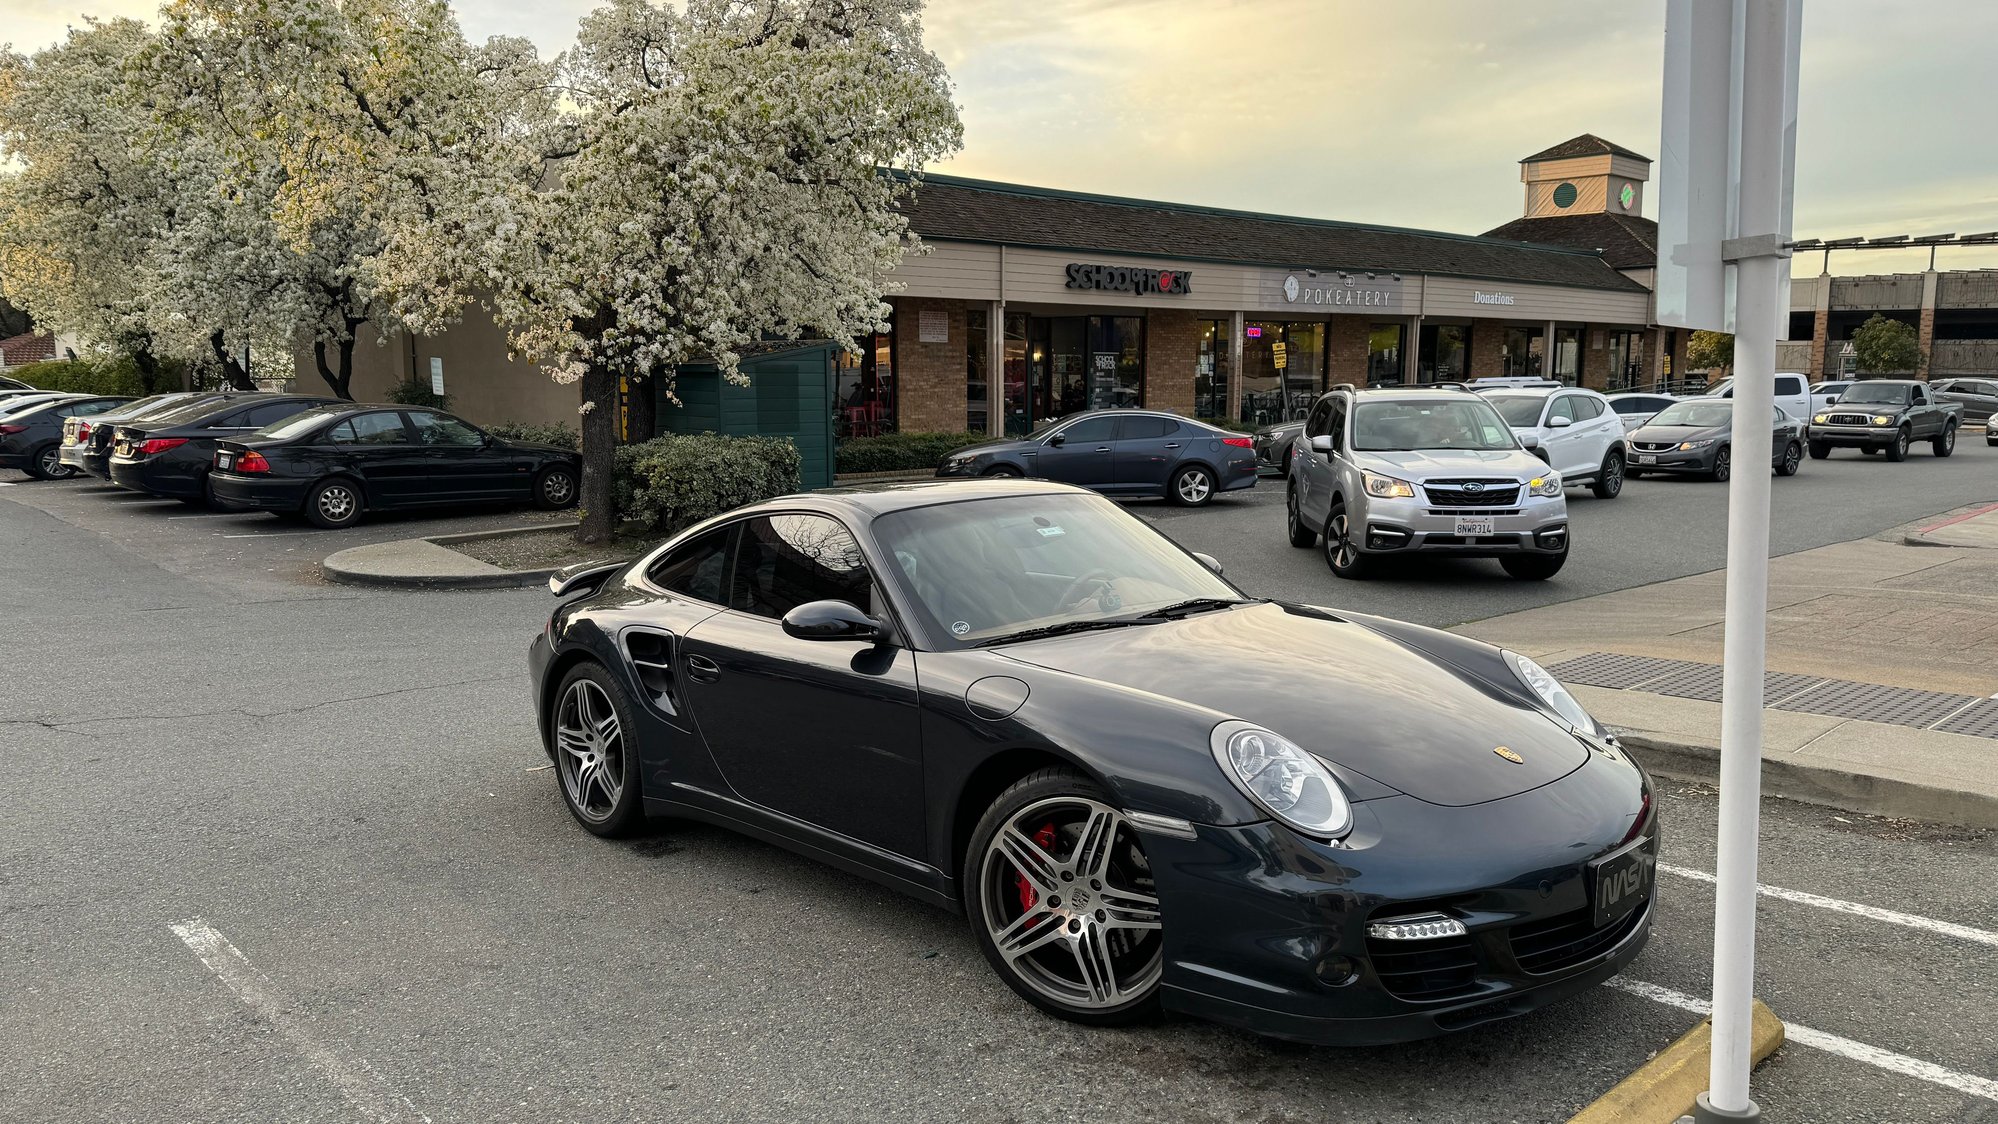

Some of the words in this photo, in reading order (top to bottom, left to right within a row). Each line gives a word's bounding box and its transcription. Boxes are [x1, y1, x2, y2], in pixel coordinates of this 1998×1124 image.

[1065, 263, 1131, 291] SCHOOL
[1147, 269, 1192, 293] ROCK
[1304, 288, 1390, 306] POKEATERY
[1474, 291, 1514, 305] Donations
[1457, 524, 1492, 534] 8NWR314
[1602, 857, 1649, 909] NASA
